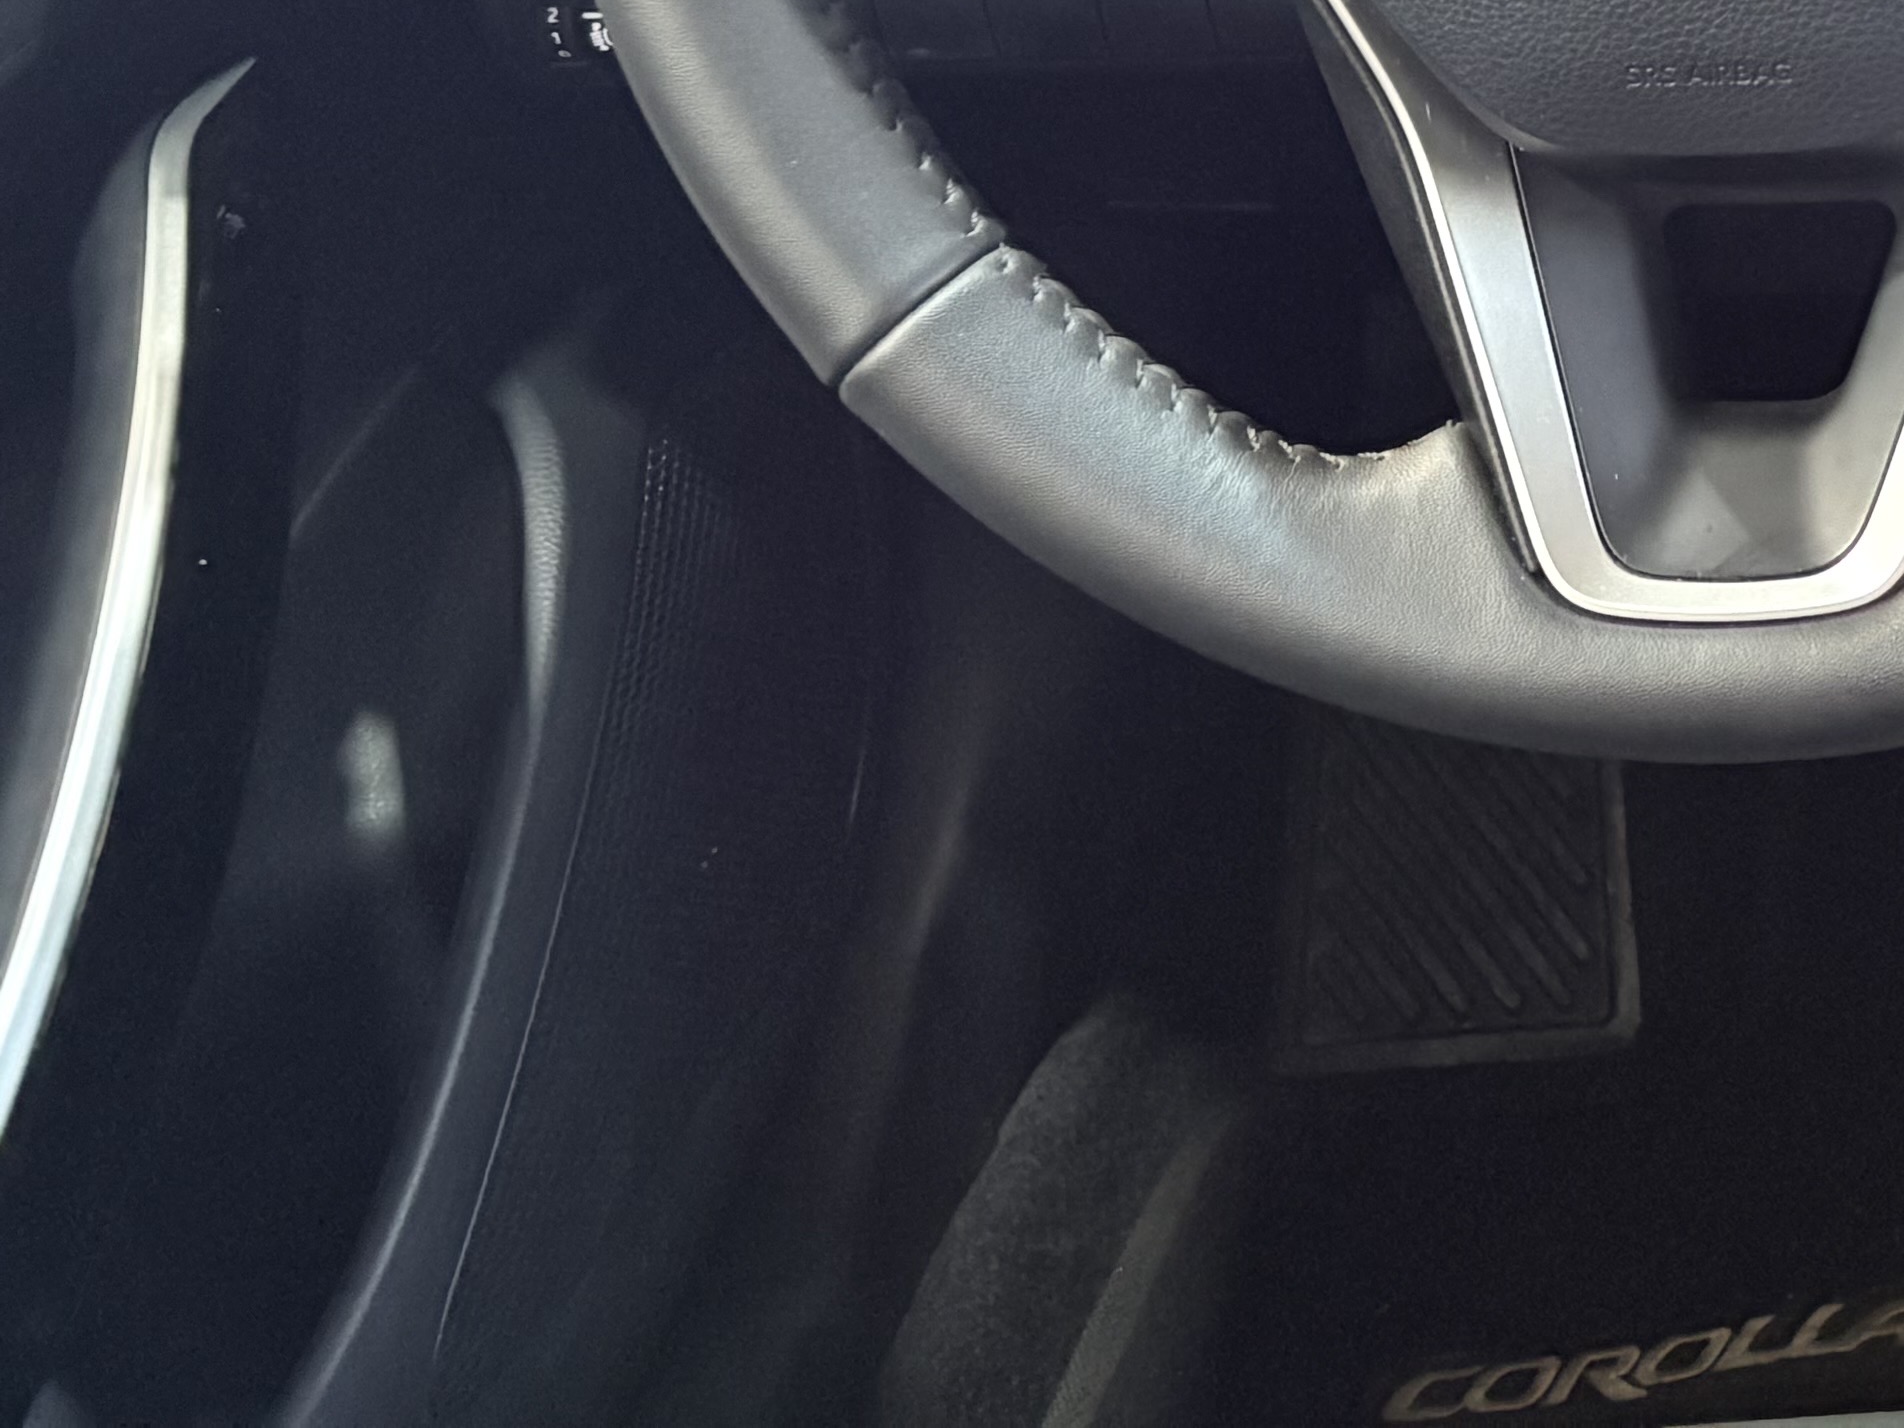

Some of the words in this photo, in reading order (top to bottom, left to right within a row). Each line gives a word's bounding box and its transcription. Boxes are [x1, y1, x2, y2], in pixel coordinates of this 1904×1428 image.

[547, 7, 560, 23] 2
[1624, 65, 1677, 89] SRS
[1689, 61, 1795, 89] AIRBAG
